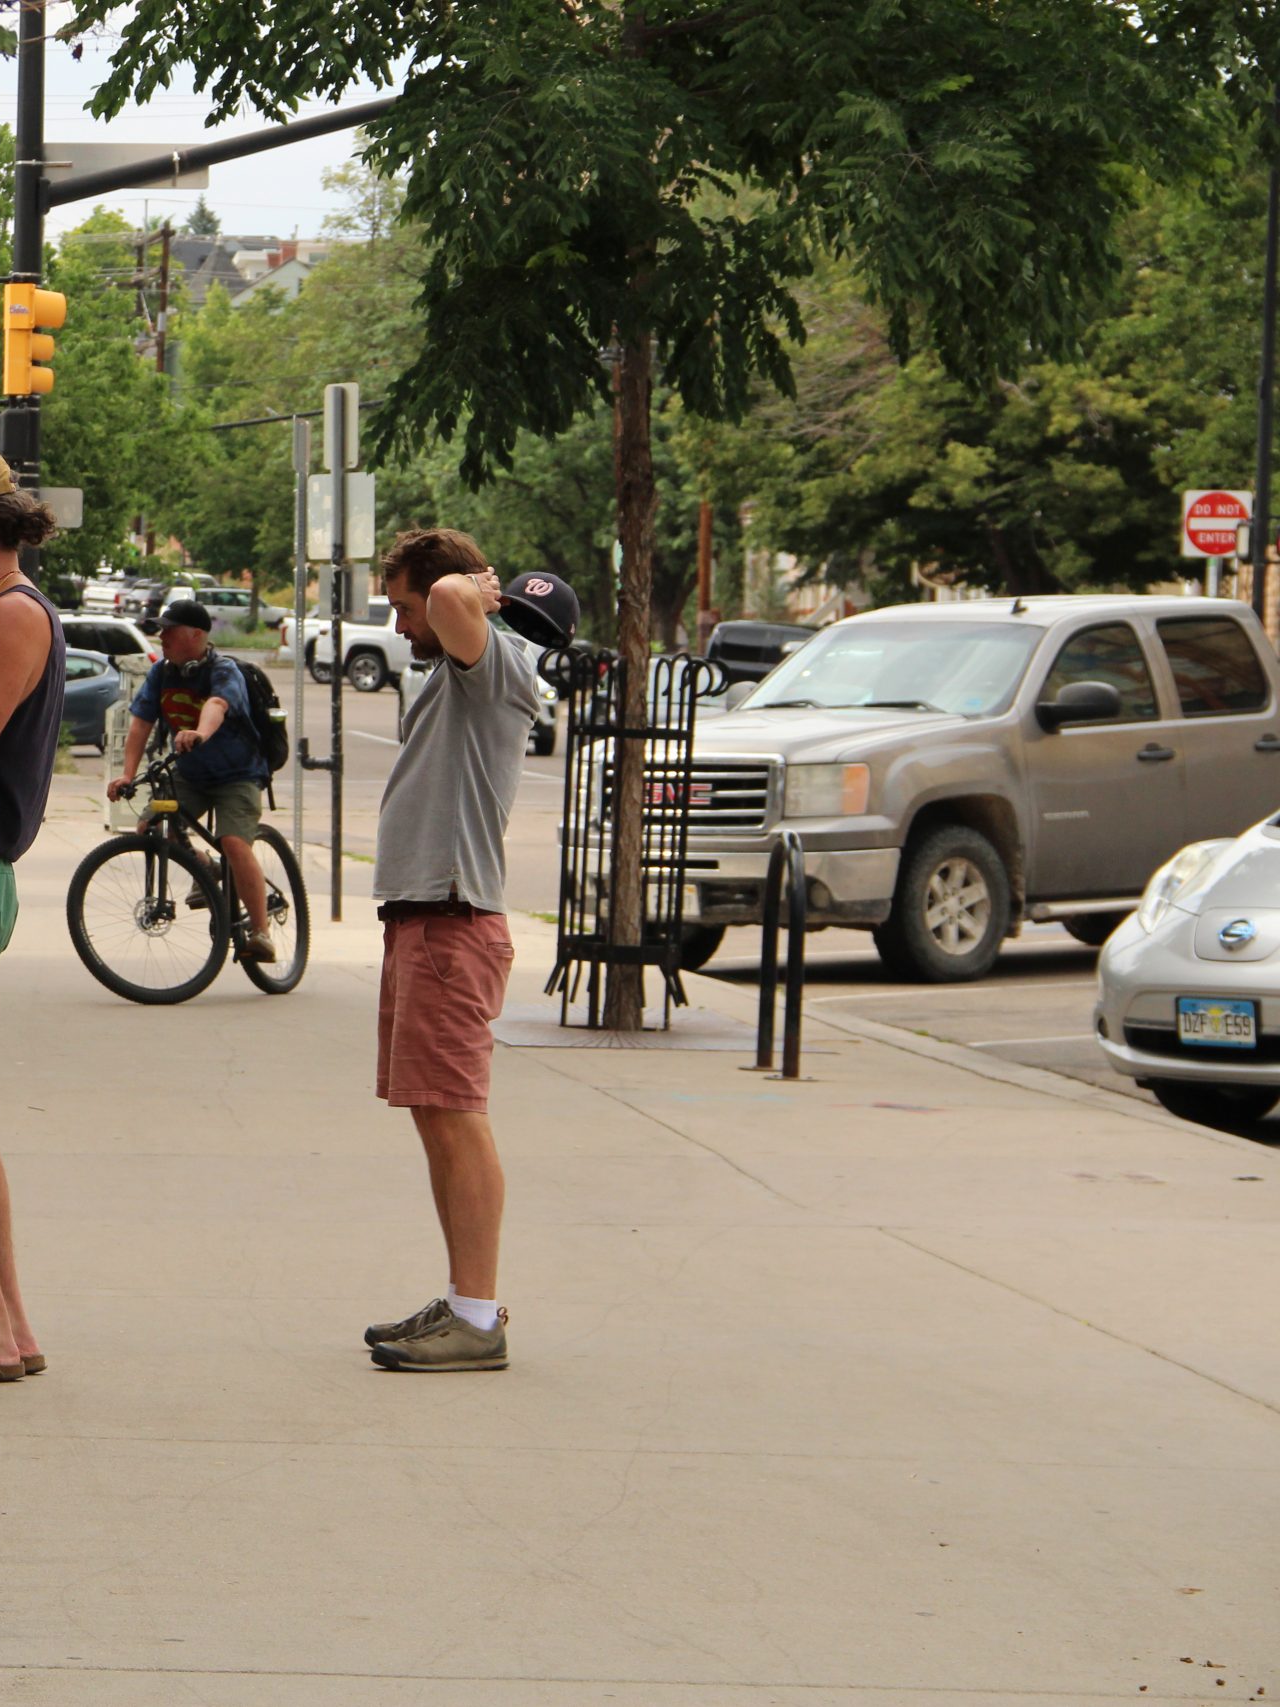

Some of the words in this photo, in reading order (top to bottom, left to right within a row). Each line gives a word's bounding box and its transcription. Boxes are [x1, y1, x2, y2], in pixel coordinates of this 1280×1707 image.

[1195, 503, 1211, 515] DO
[1216, 503, 1241, 515] NOT
[1199, 532, 1236, 544] ENTER
[524, 578, 554, 597] W
[1183, 1012, 1208, 1034] DZF
